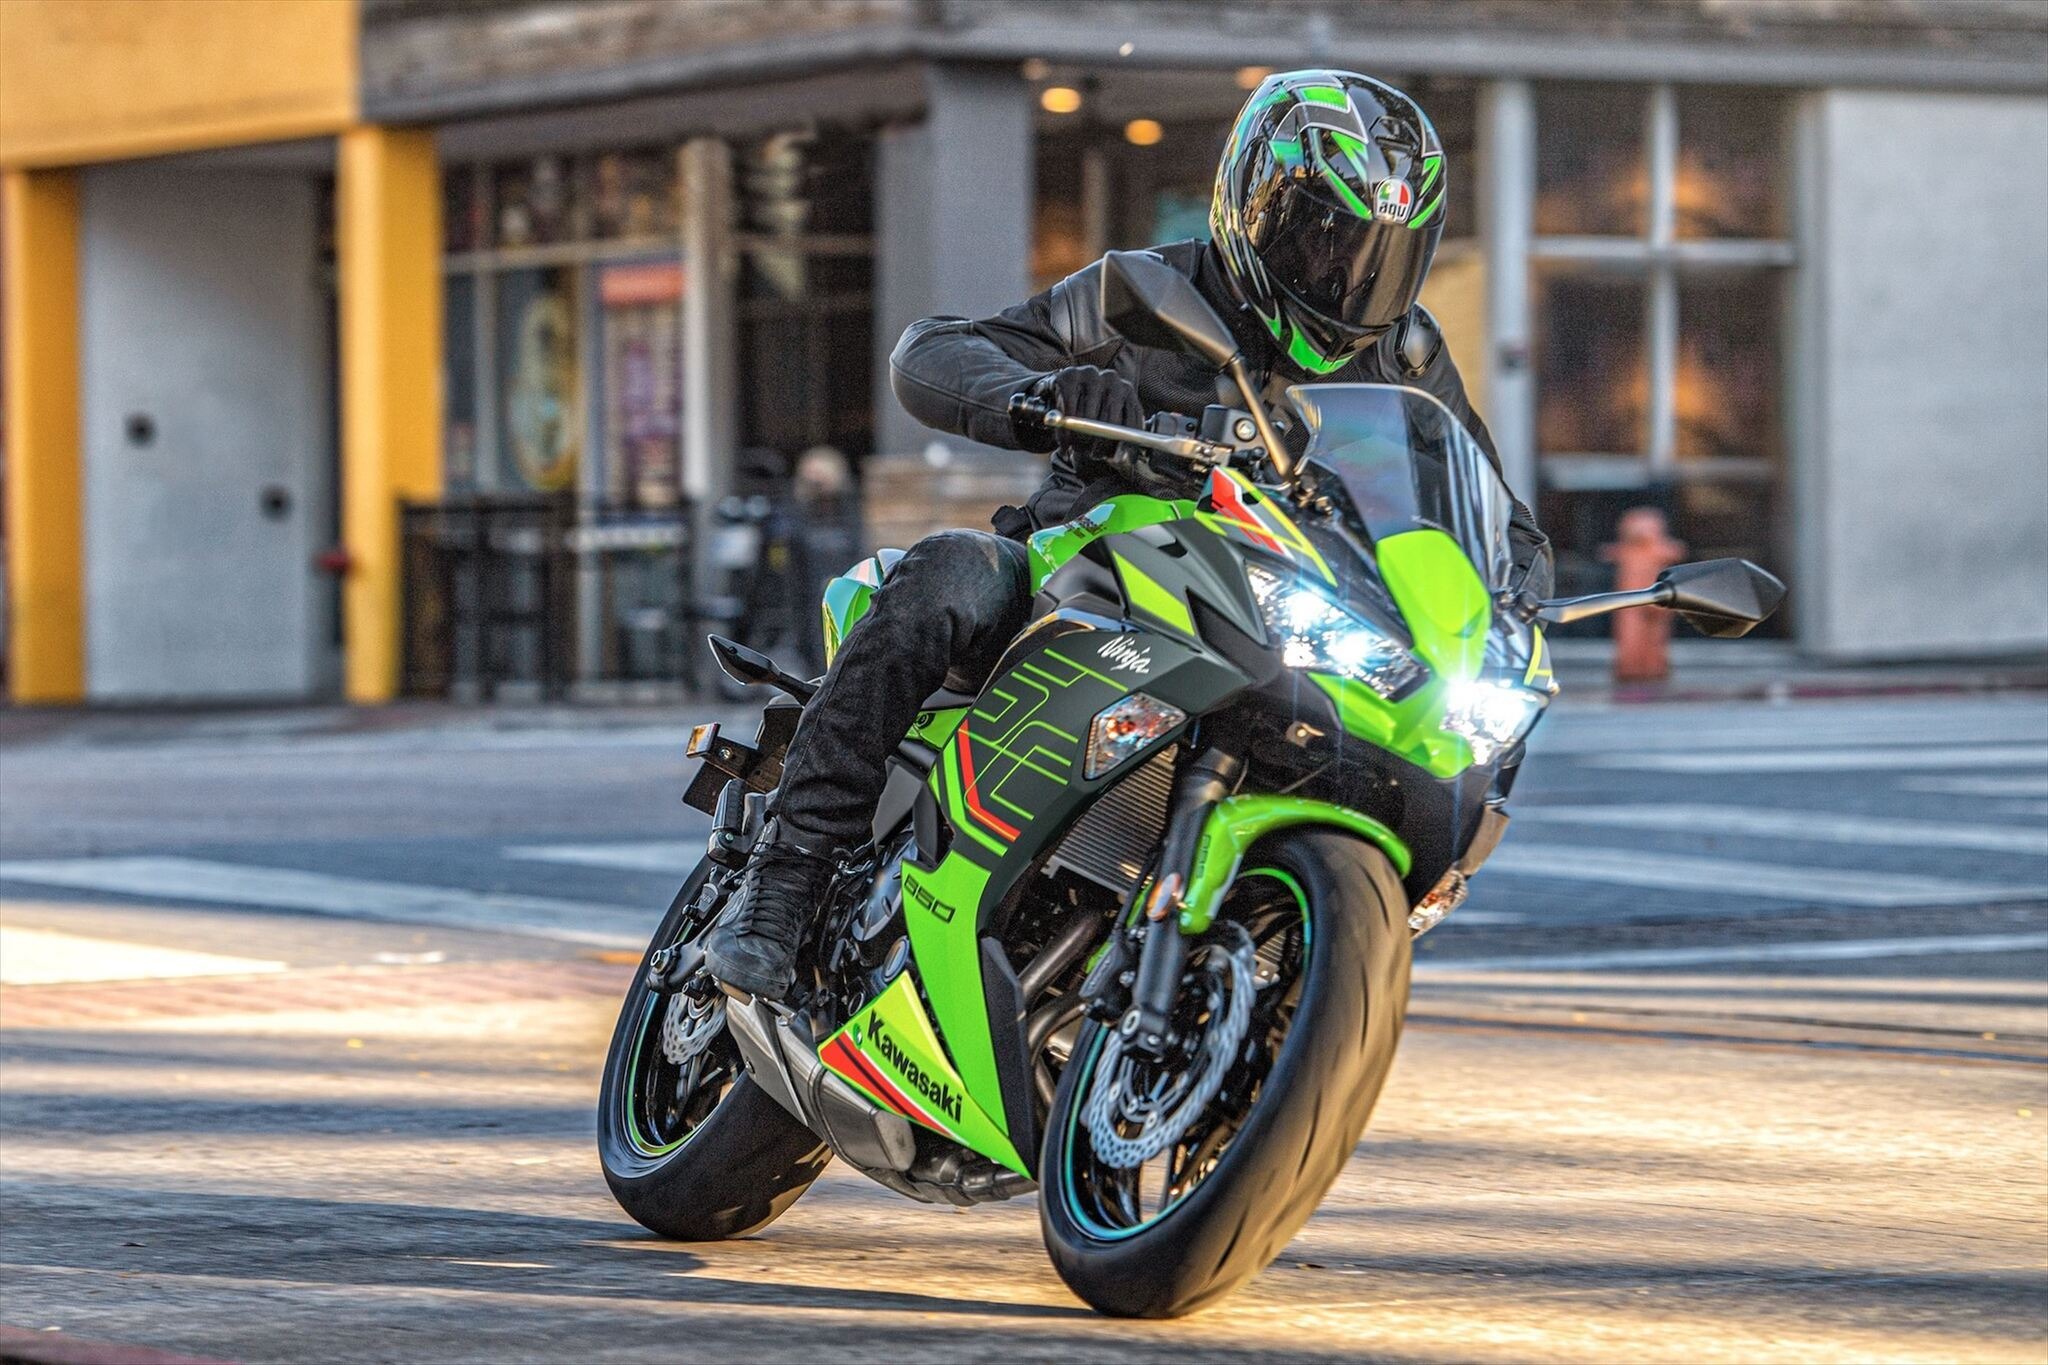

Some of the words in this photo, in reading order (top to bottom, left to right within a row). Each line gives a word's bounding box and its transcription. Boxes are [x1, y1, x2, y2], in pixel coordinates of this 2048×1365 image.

[1097, 635, 1151, 674] Ninja
[904, 874, 956, 923] 650
[867, 1009, 963, 1124] Kawasaki
